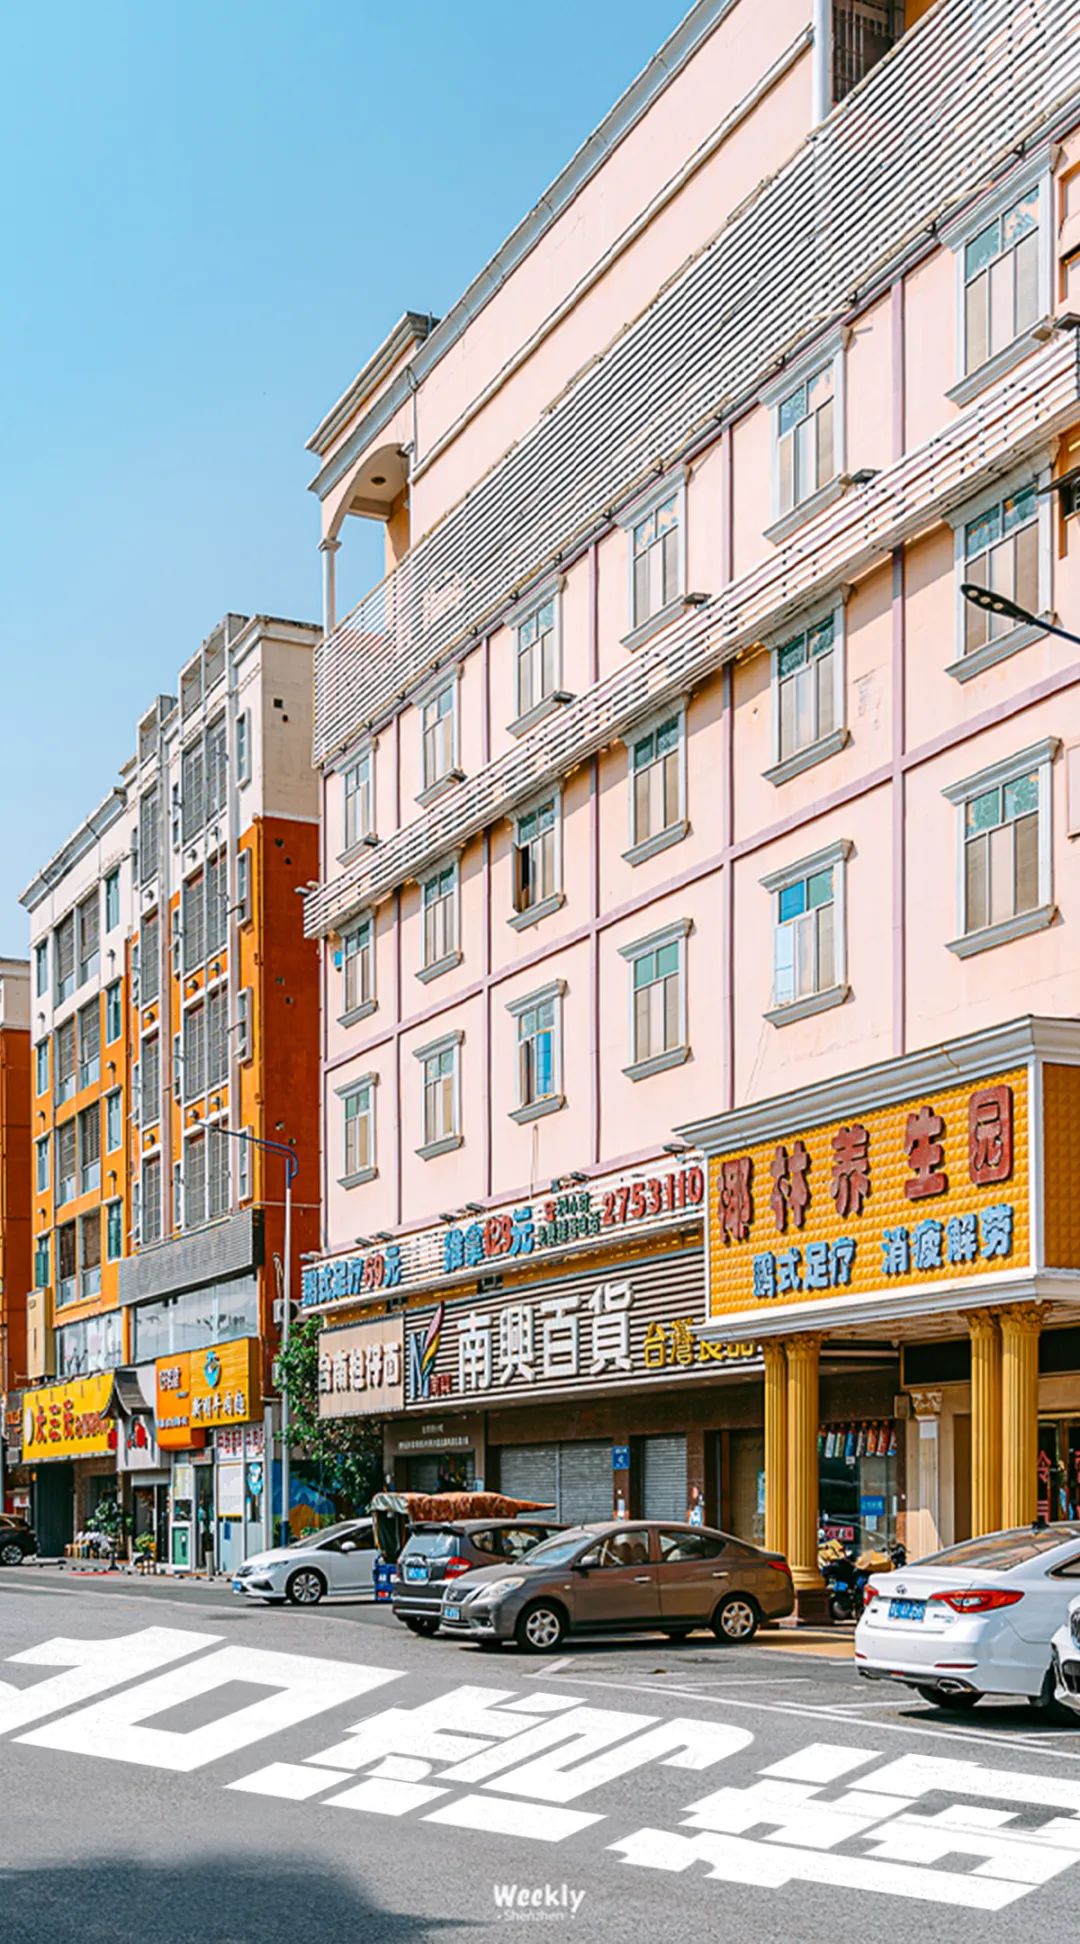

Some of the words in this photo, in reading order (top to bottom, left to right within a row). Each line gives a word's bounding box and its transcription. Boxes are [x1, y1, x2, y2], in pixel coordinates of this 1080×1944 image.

[881, 1203, 1015, 1274] 消疲解劳
[457, 1280, 634, 1393] 南興百貨
